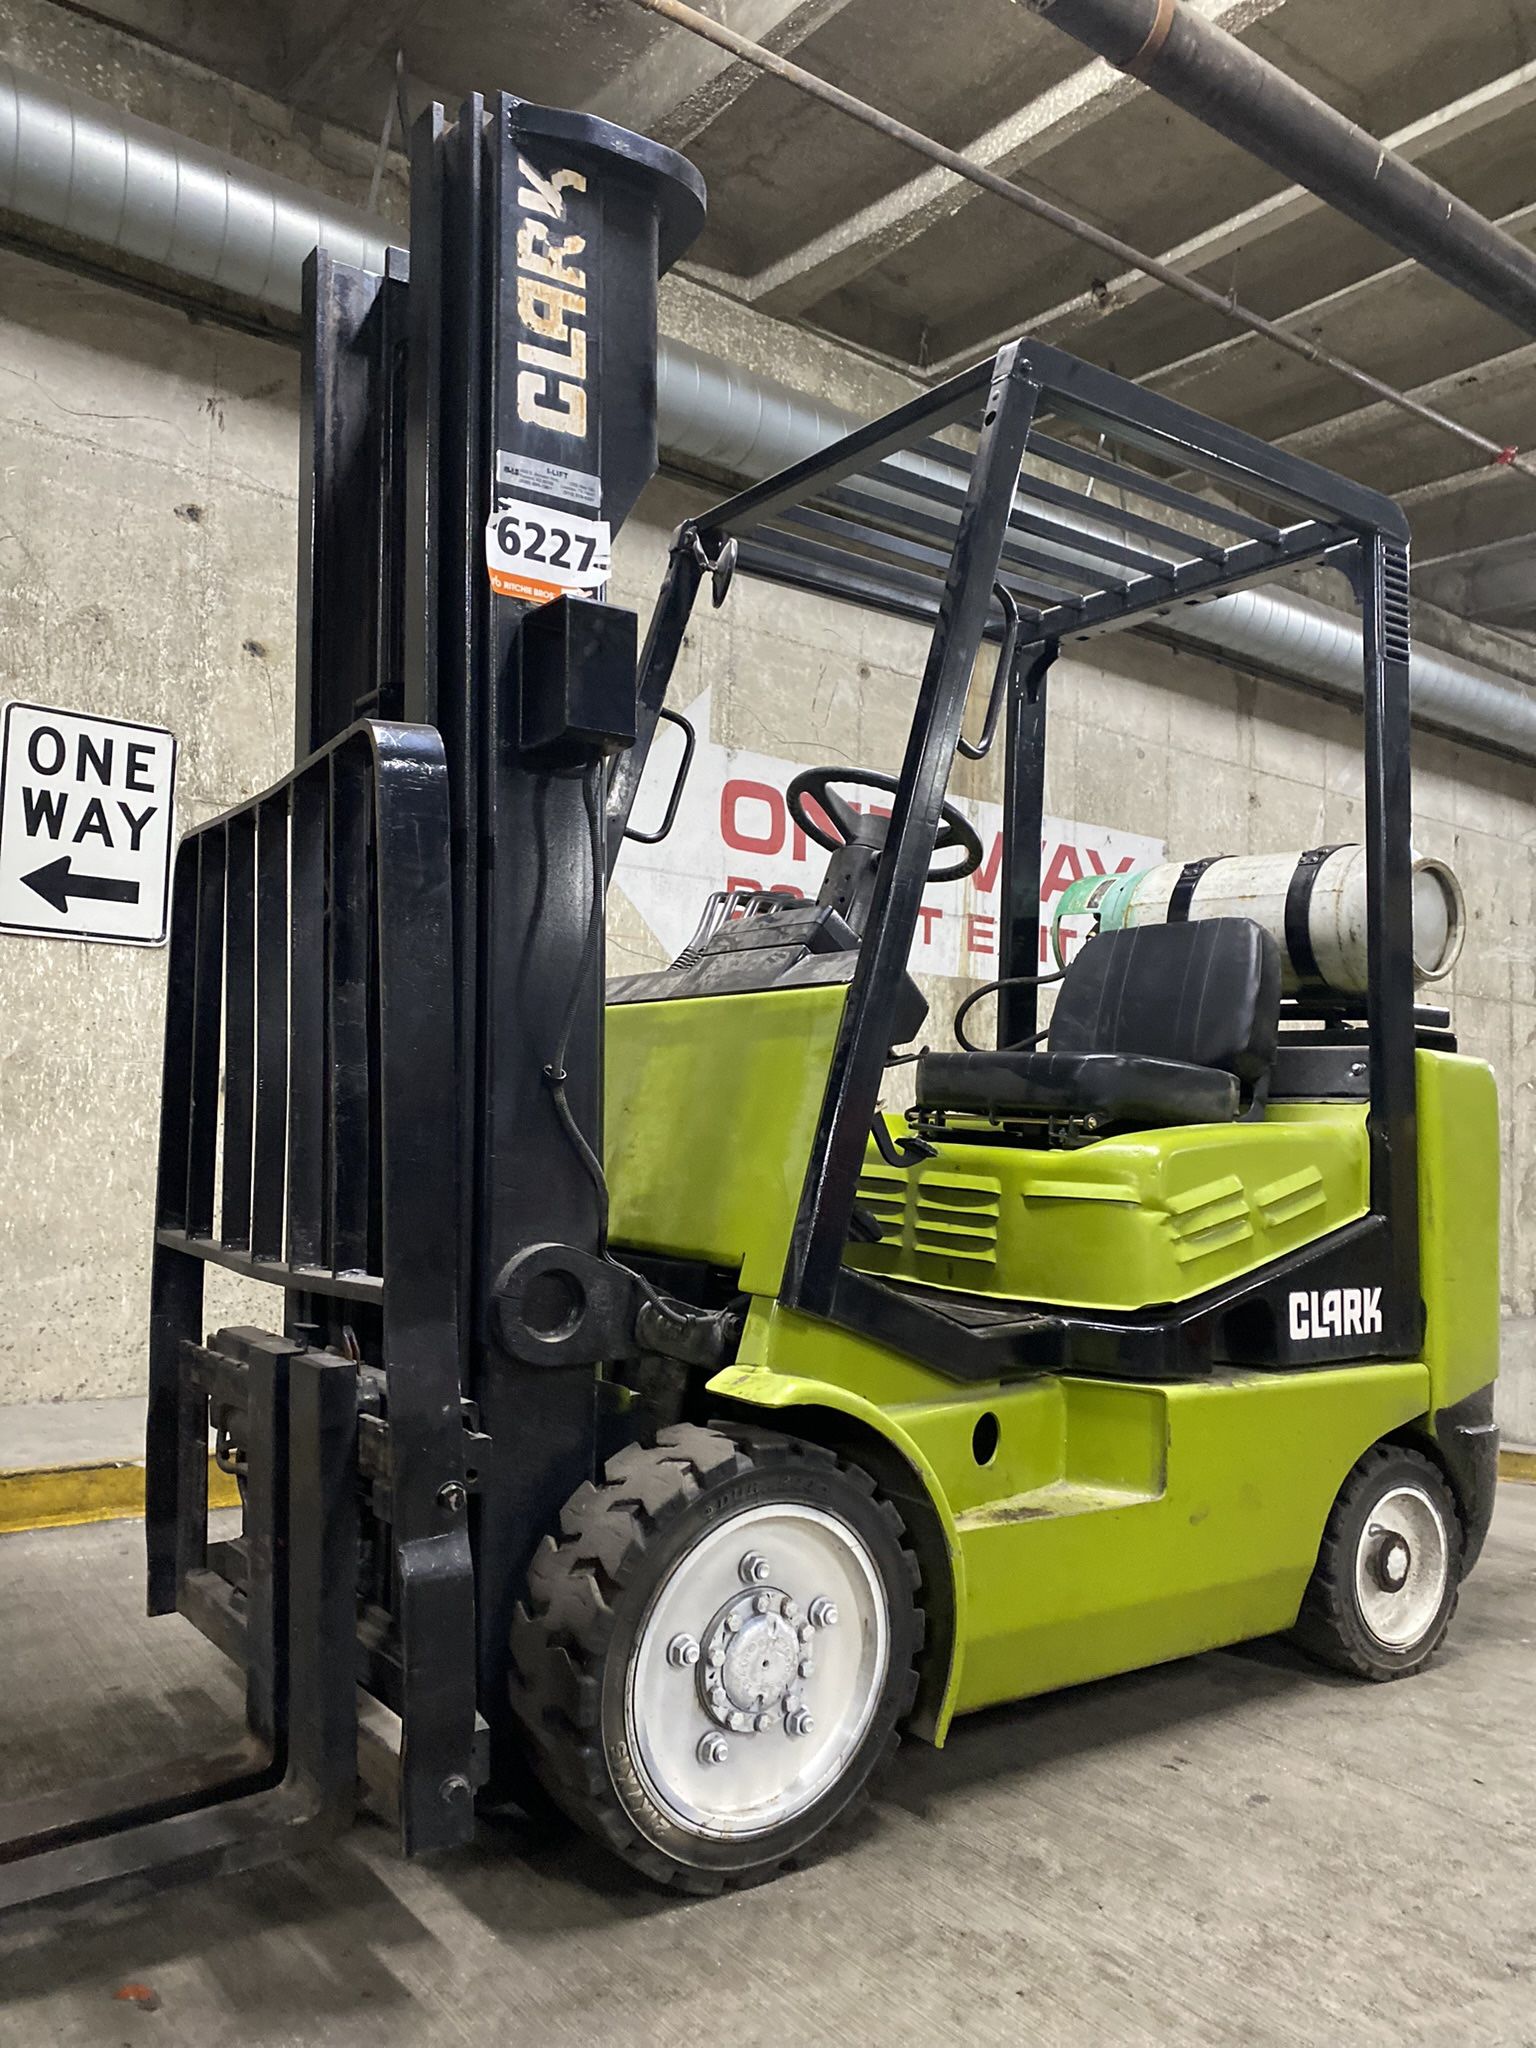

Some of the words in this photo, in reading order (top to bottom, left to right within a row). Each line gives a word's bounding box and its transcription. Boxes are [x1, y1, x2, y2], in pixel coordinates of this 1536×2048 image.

[517, 158, 587, 437] CLARK
[497, 516, 597, 572] 6227
[503, 581, 532, 595] RITCHIE
[28, 725, 156, 794] ONE
[22, 786, 158, 851] WAY
[720, 779, 892, 861] ON
[967, 913, 1078, 965] EIT
[1288, 1287, 1383, 1340] CLARK
